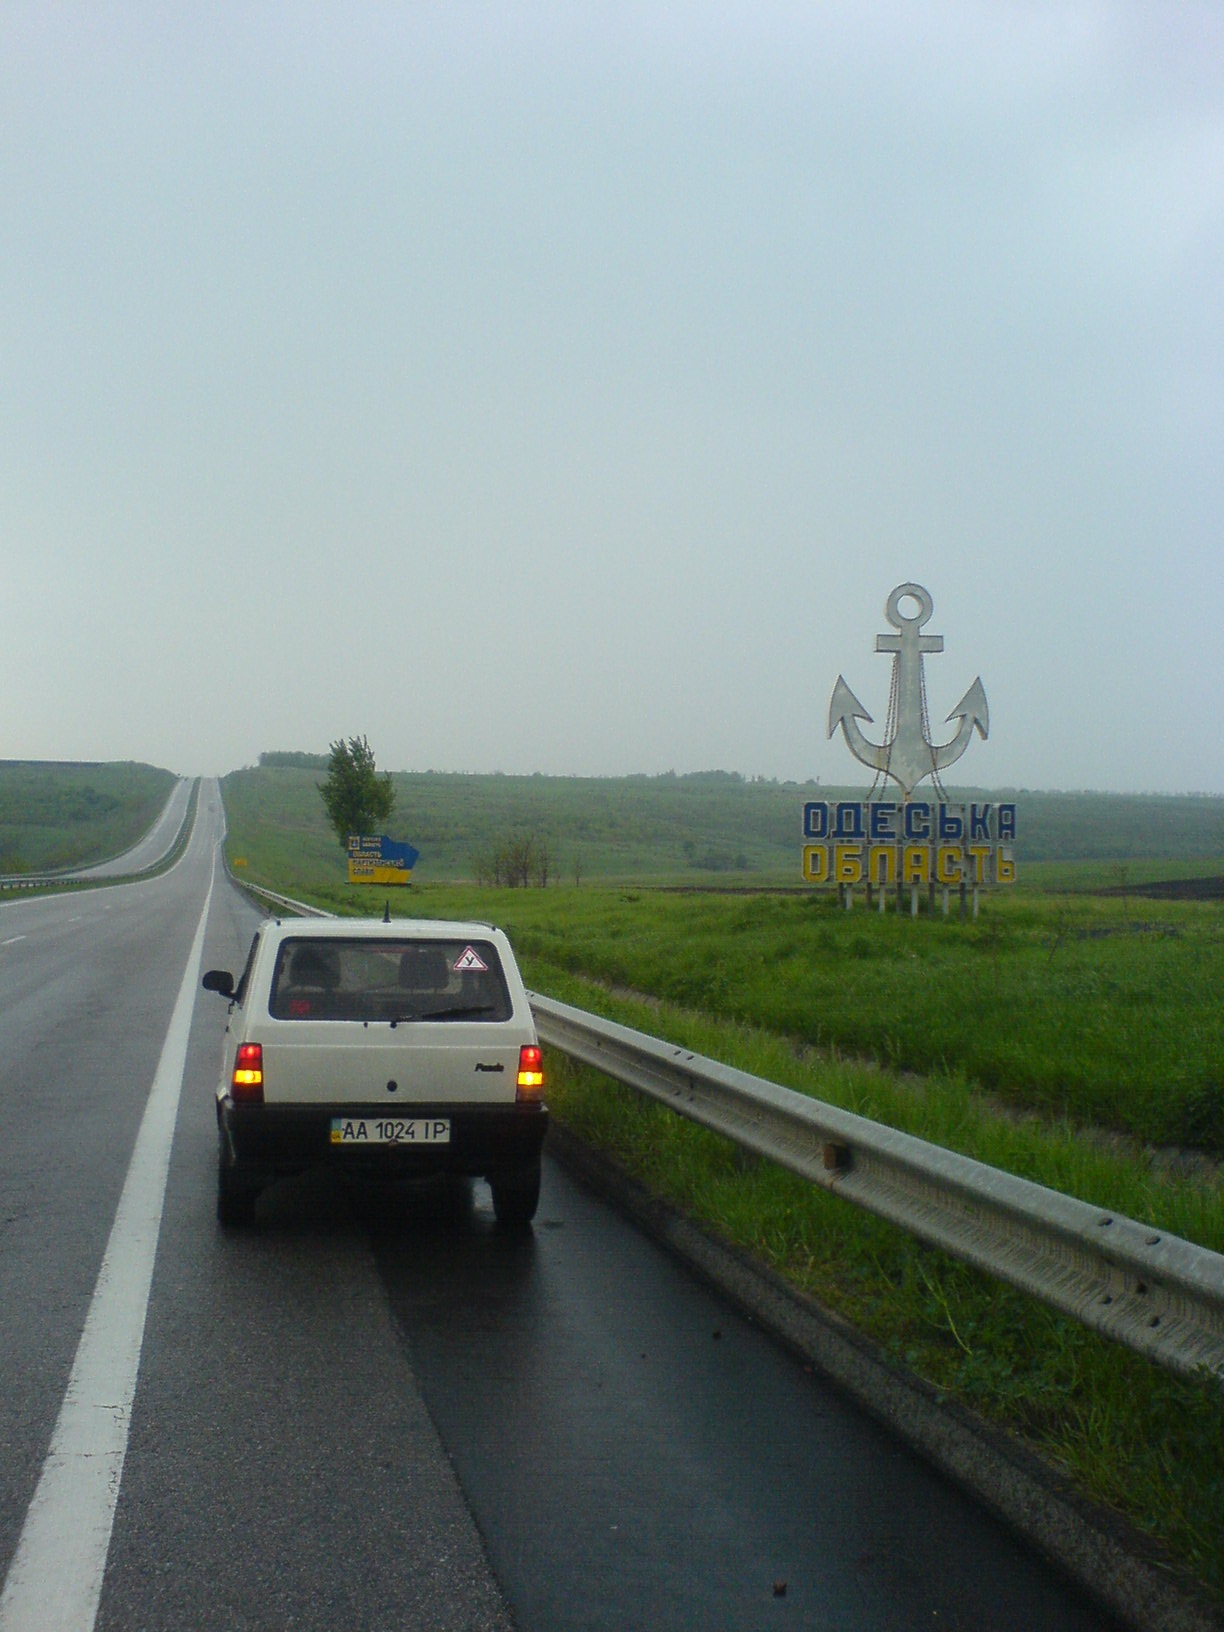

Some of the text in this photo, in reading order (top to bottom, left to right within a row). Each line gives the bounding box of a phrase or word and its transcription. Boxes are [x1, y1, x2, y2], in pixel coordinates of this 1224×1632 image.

[803, 802, 1016, 839] ОДЕСЬКА
[802, 844, 1016, 883] ОБЛАСТЬ
[343, 1121, 447, 1139] AA 1024 IP
